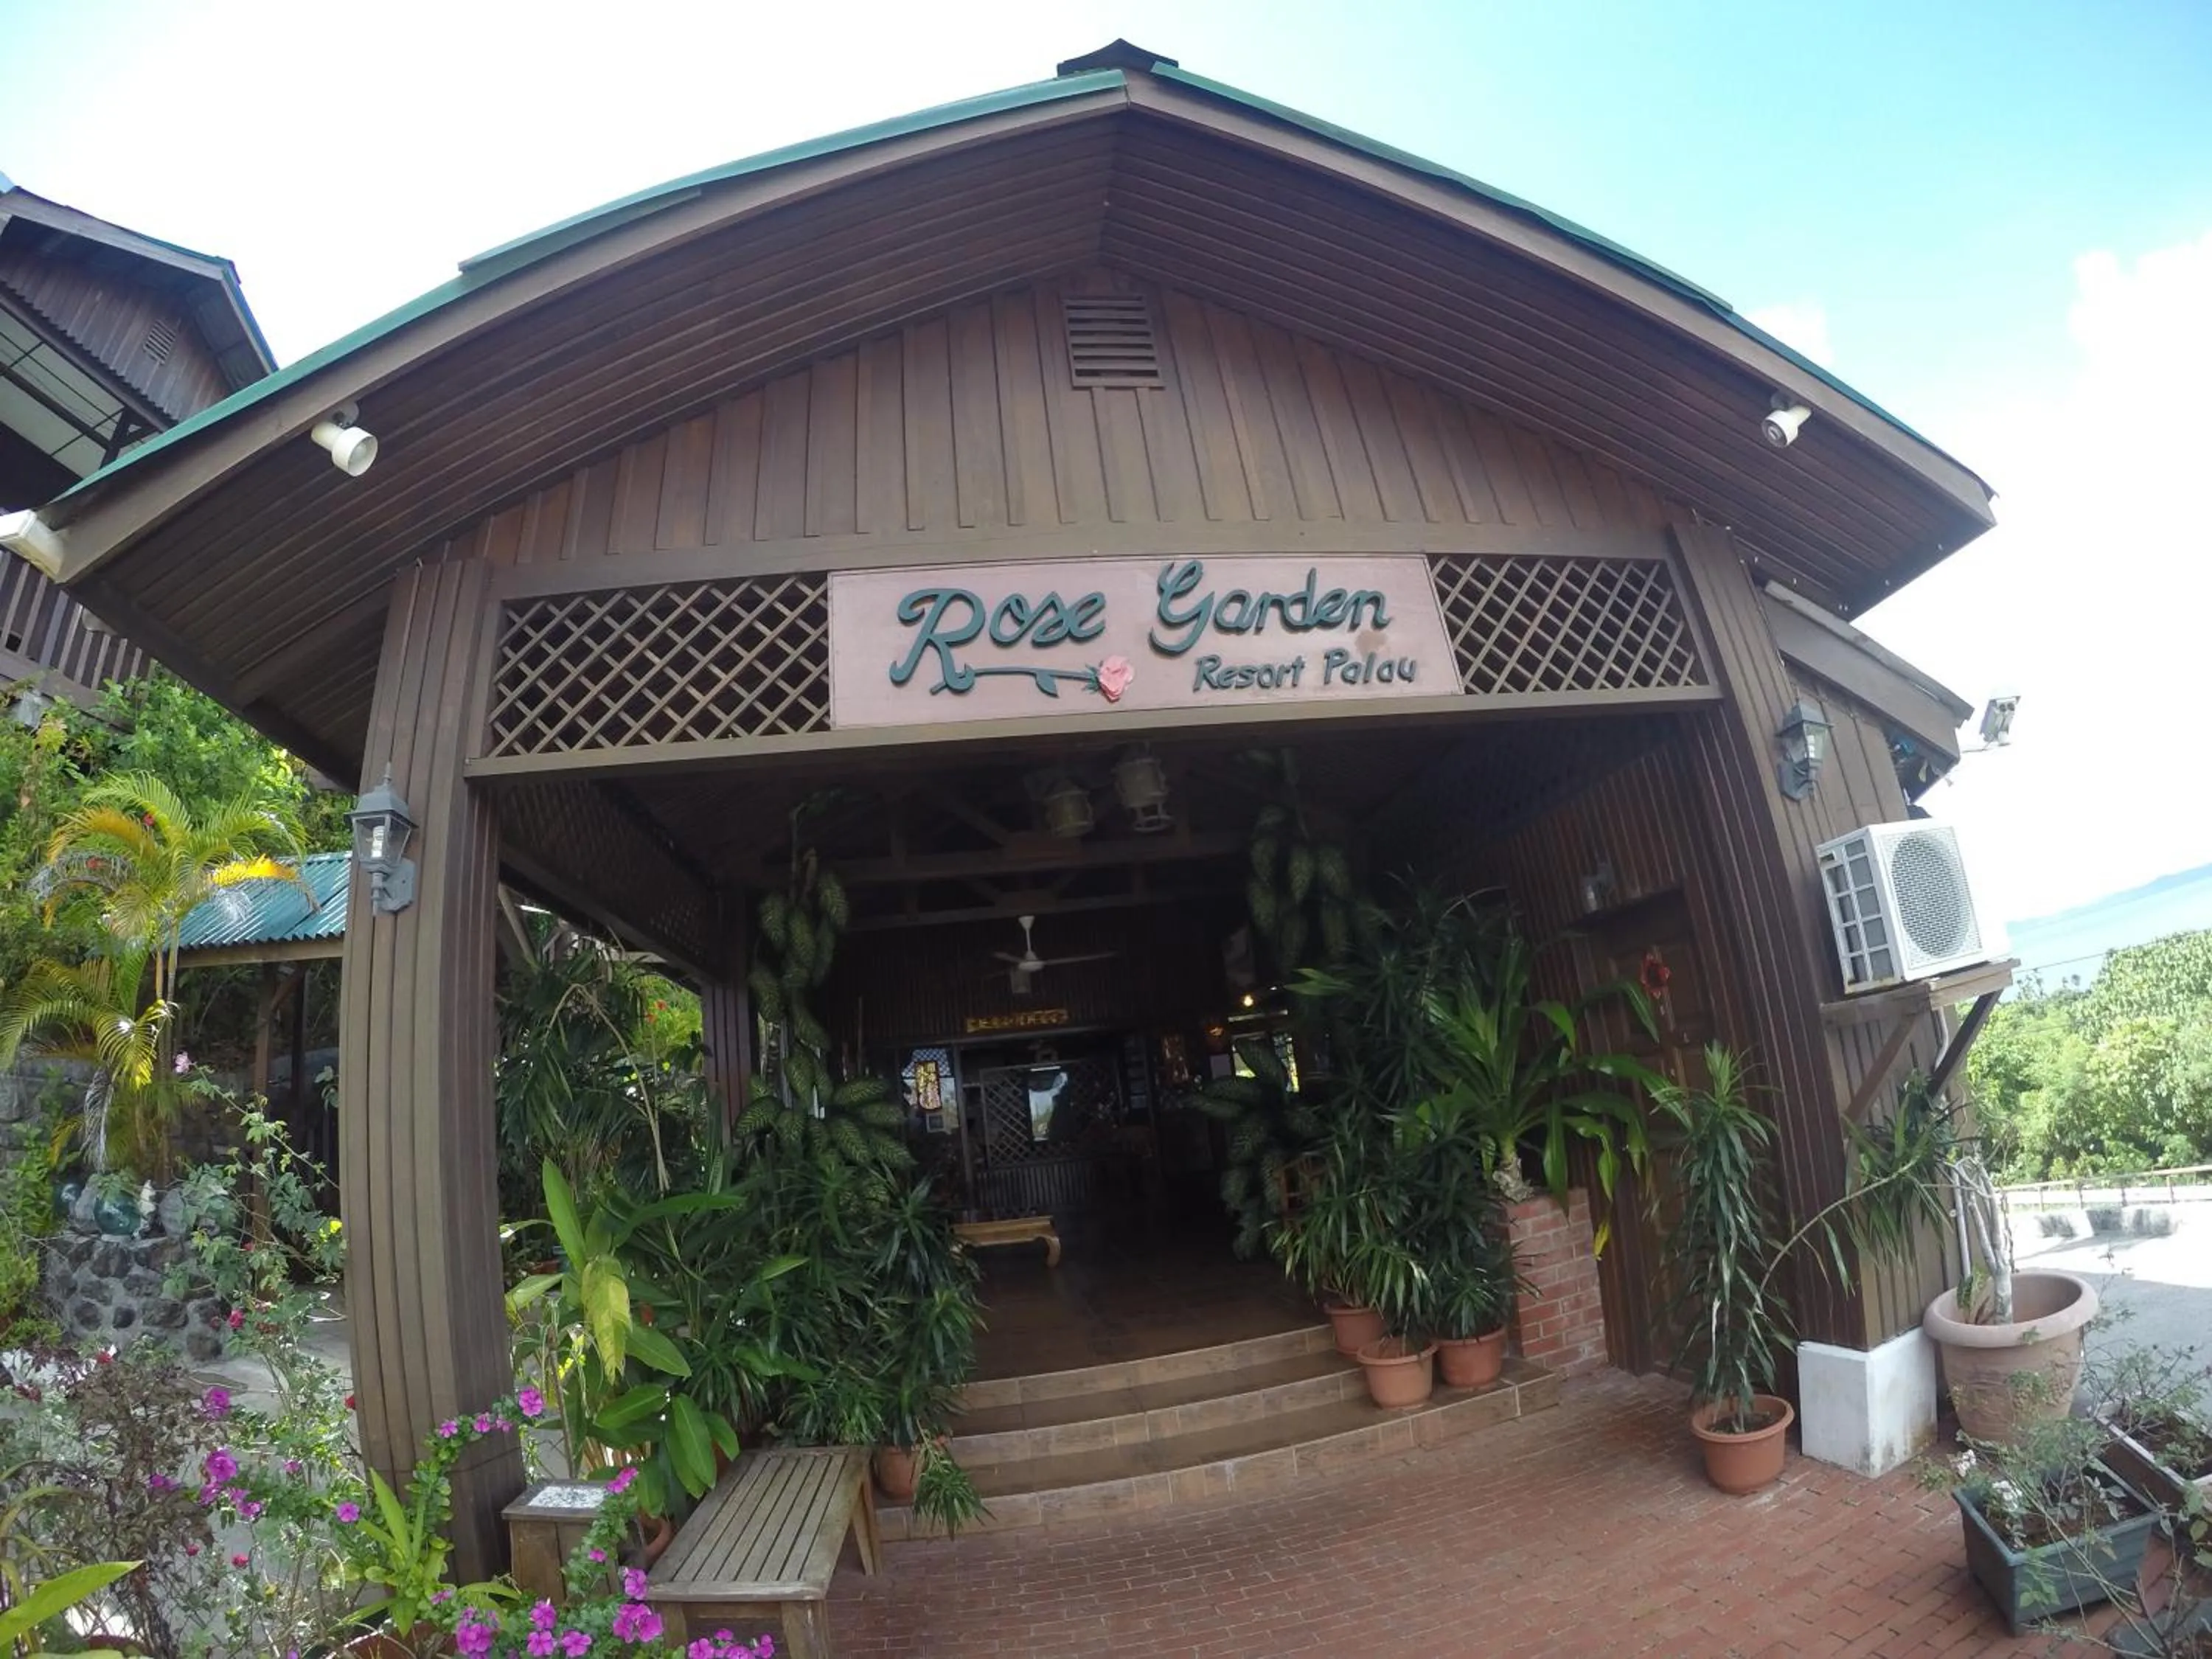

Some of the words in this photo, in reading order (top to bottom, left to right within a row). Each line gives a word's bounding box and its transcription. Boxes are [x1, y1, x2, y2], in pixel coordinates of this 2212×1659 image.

[889, 588, 1106, 693] Rose
[1148, 560, 1393, 654] Garden
[1193, 654, 1305, 692] Resort
[1324, 647, 1416, 685] Palau
